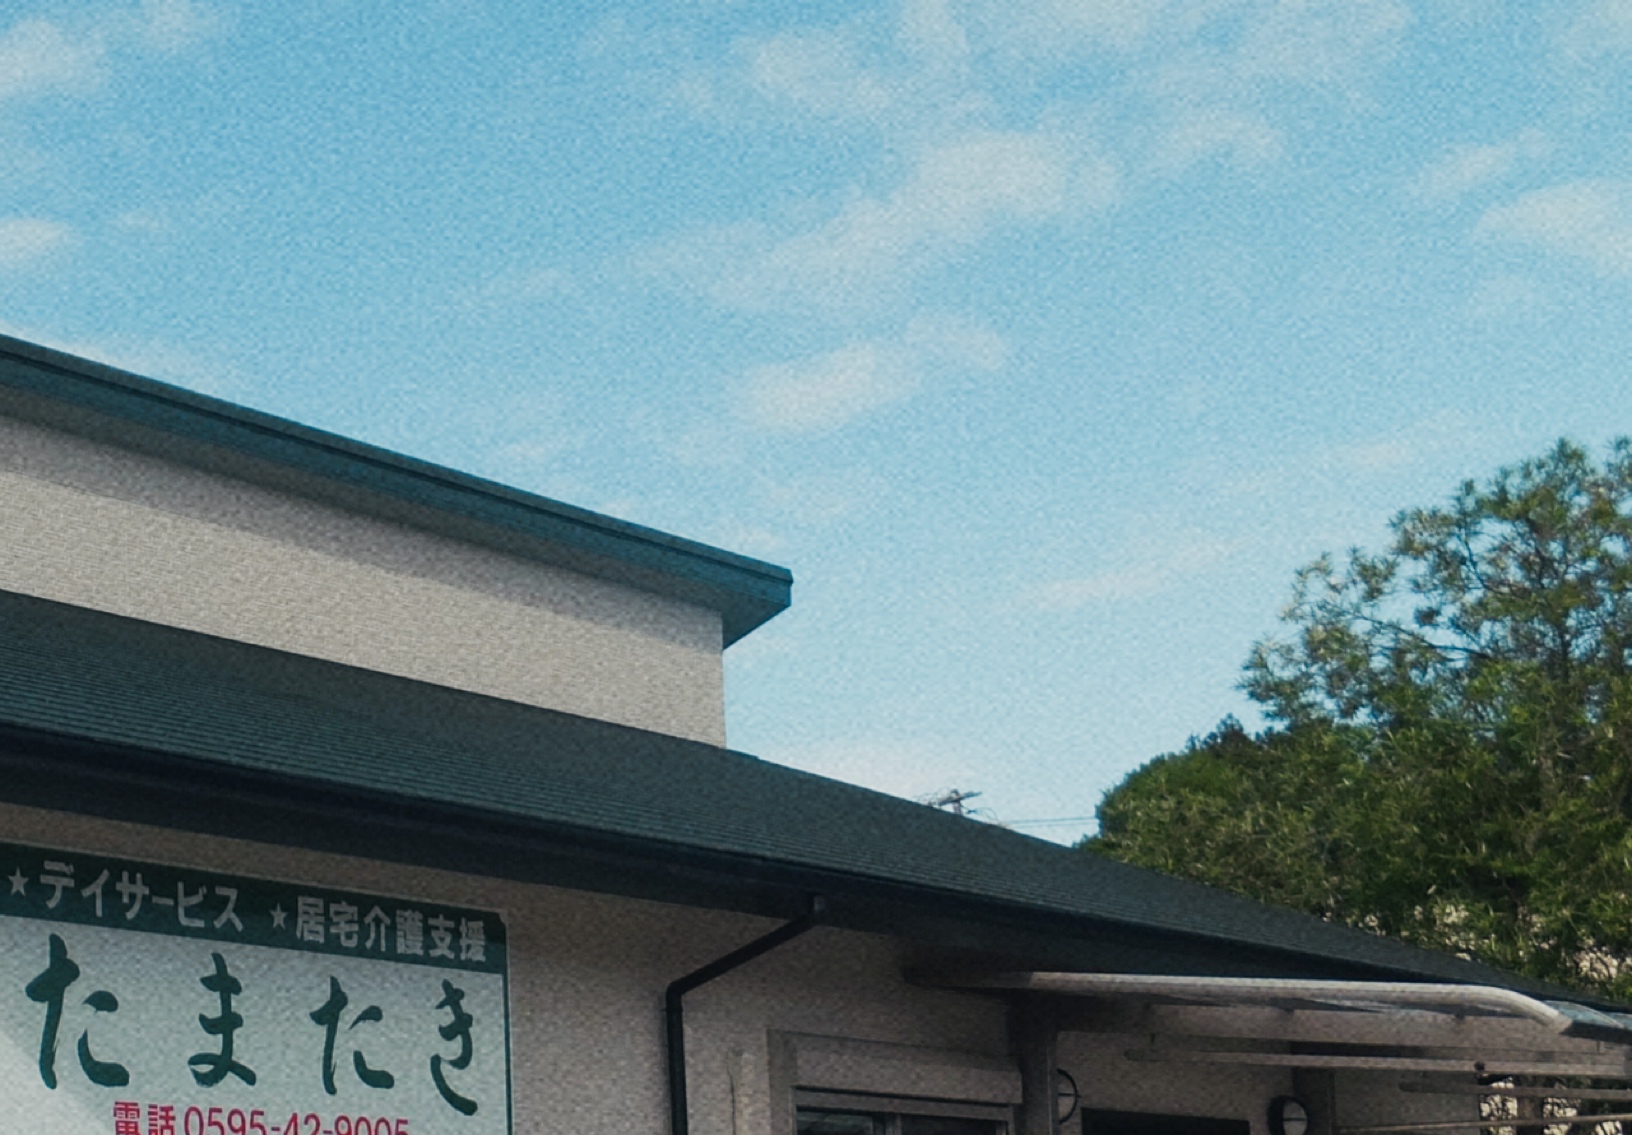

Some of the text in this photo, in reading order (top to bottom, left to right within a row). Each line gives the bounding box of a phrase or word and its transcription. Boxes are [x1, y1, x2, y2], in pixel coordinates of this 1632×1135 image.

[40, 860, 487, 962] デイサービス 居宅介護支援
[25, 933, 478, 1116] たまたき
